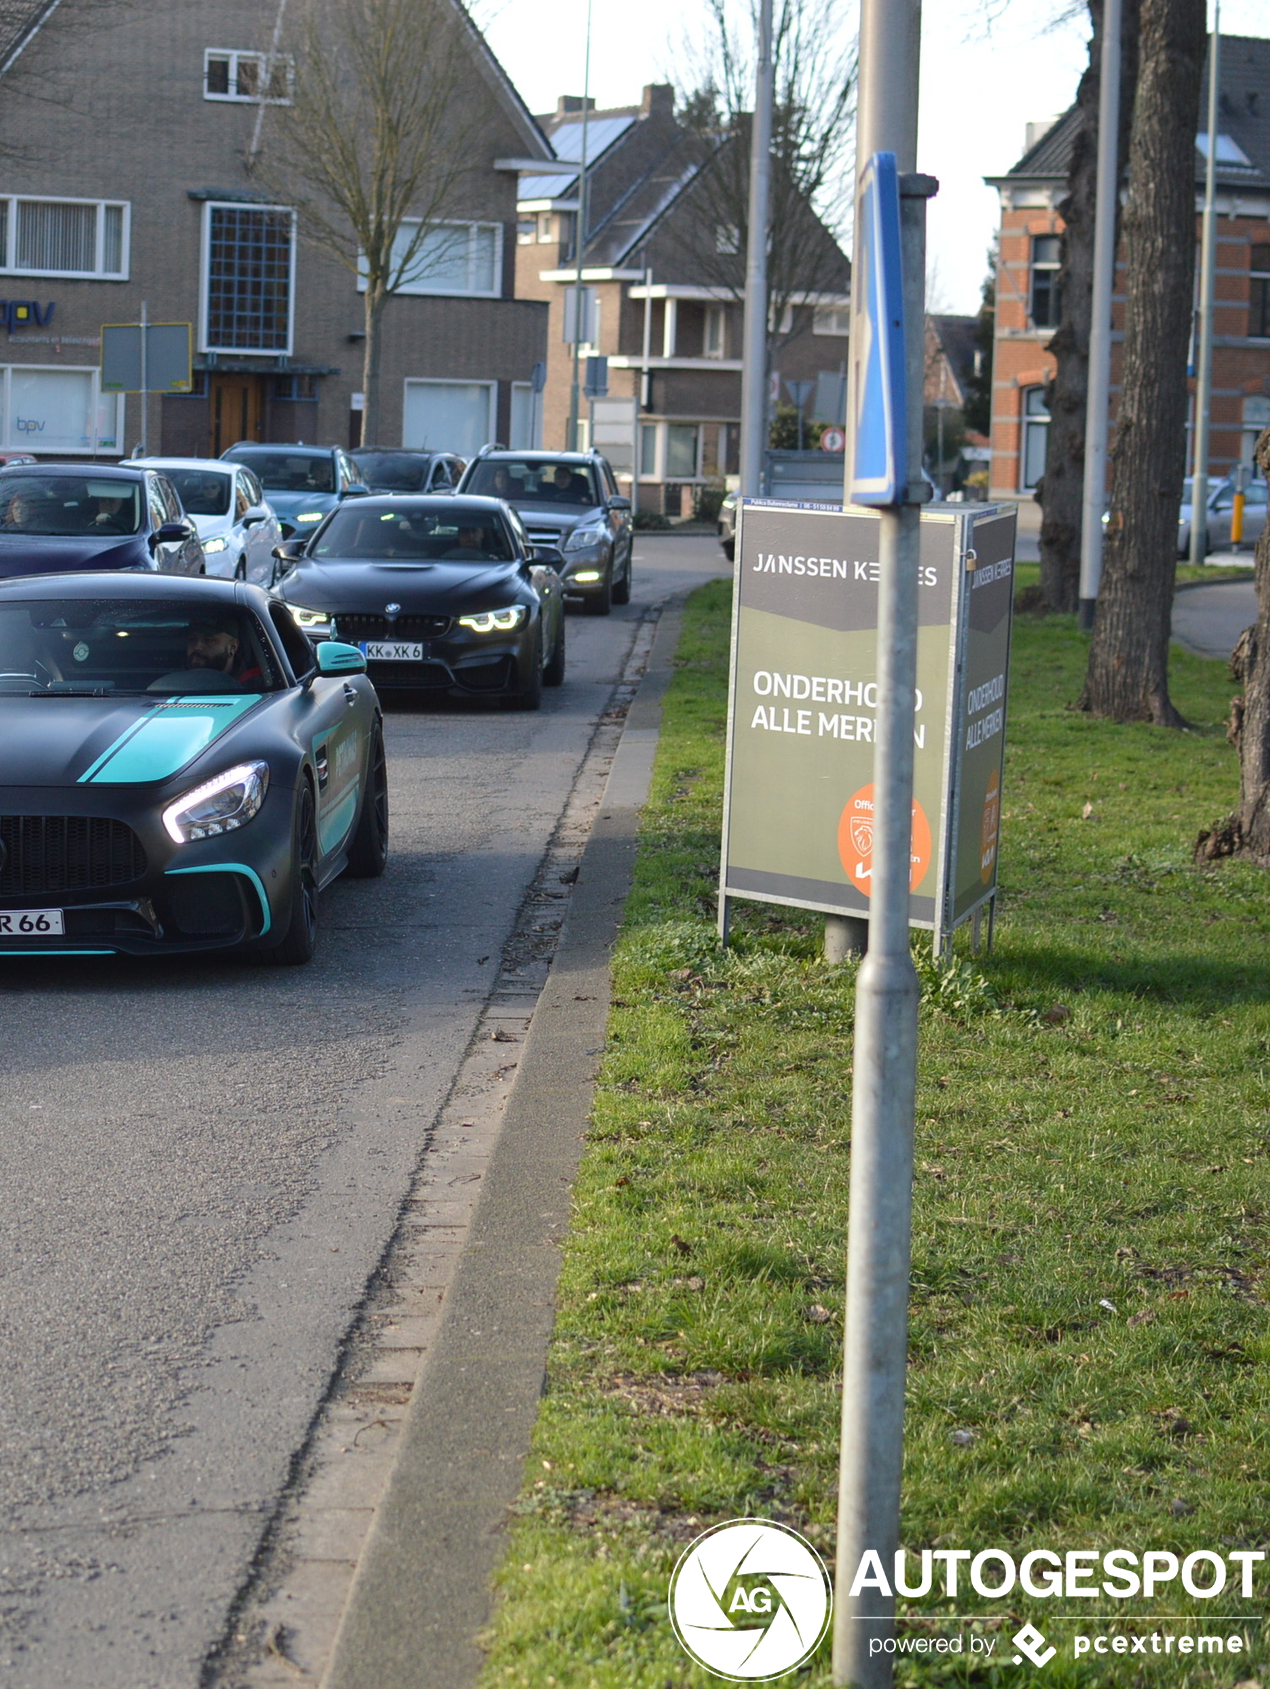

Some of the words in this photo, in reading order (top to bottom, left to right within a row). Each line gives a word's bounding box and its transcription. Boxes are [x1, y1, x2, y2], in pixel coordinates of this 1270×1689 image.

[16, 416, 46, 435] bpv
[753, 554, 847, 579] JANSSEN
[751, 705, 812, 735] ALLE
[19, 914, 51, 932] 66
